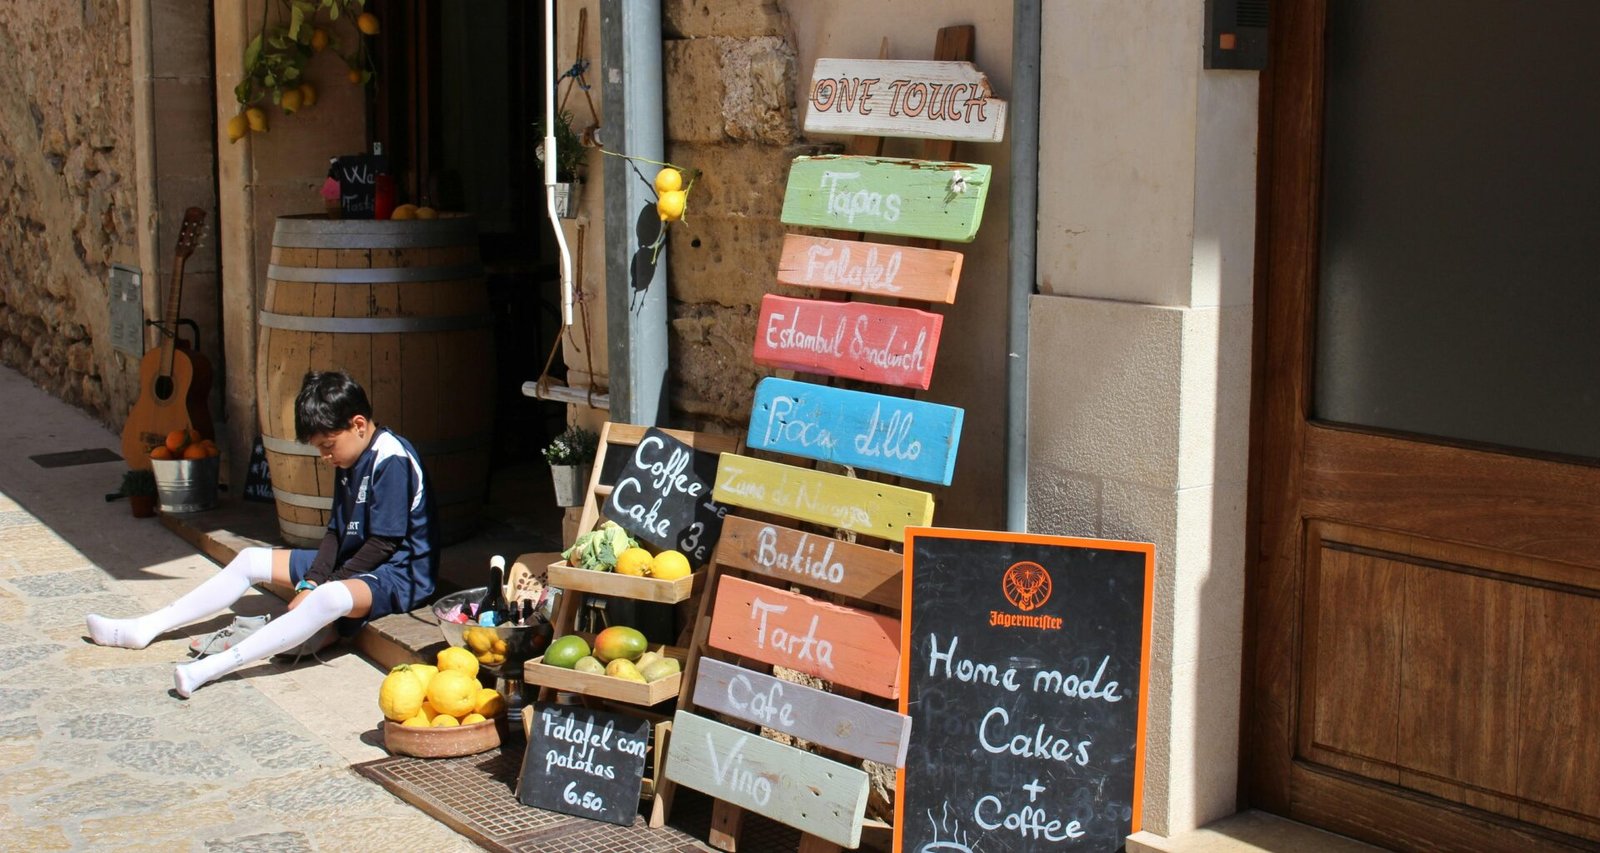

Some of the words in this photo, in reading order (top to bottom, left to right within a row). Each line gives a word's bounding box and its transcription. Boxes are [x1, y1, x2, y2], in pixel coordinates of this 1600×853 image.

[812, 77, 881, 115] ONE
[888, 79, 988, 123] TOUCH
[820, 170, 900, 223] Tapas
[806, 244, 903, 292] Falafel
[766, 306, 848, 358] Estambul
[850, 314, 927, 372] Sandwich
[635, 436, 703, 497] Coffee
[719, 465, 767, 501] Zumo
[612, 476, 671, 539] Cake
[680, 520, 706, 560] 3€
[754, 526, 844, 584] Batido
[751, 597, 834, 670] Tarta
[989, 610, 1063, 631] Jägermeister
[929, 632, 1020, 690] Home
[1033, 655, 1123, 702] made
[727, 674, 795, 727] Cafe
[541, 707, 615, 759] Falafel
[617, 737, 646, 759] con
[979, 706, 1092, 767] Cakes
[545, 745, 615, 779] patatas
[706, 732, 772, 806] Vino
[974, 795, 1085, 842] Coffee
